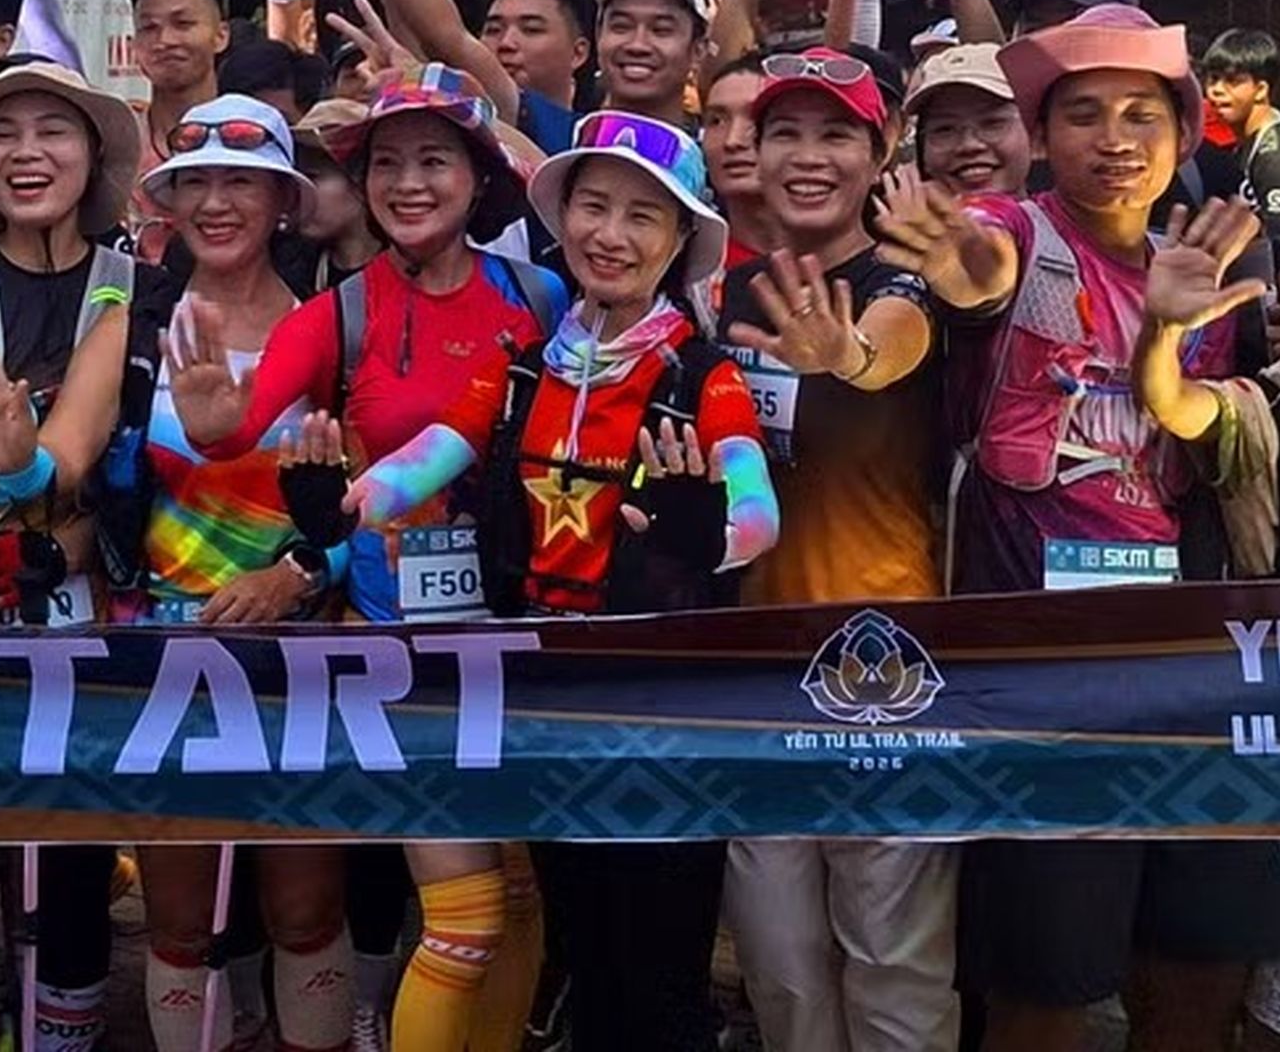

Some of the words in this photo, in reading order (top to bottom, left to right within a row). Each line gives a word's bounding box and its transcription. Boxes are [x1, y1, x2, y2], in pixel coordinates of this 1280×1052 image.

[849, 732, 908, 748] ULTRA
[914, 731, 967, 748] TRAIL
[849, 756, 904, 770] 2026
